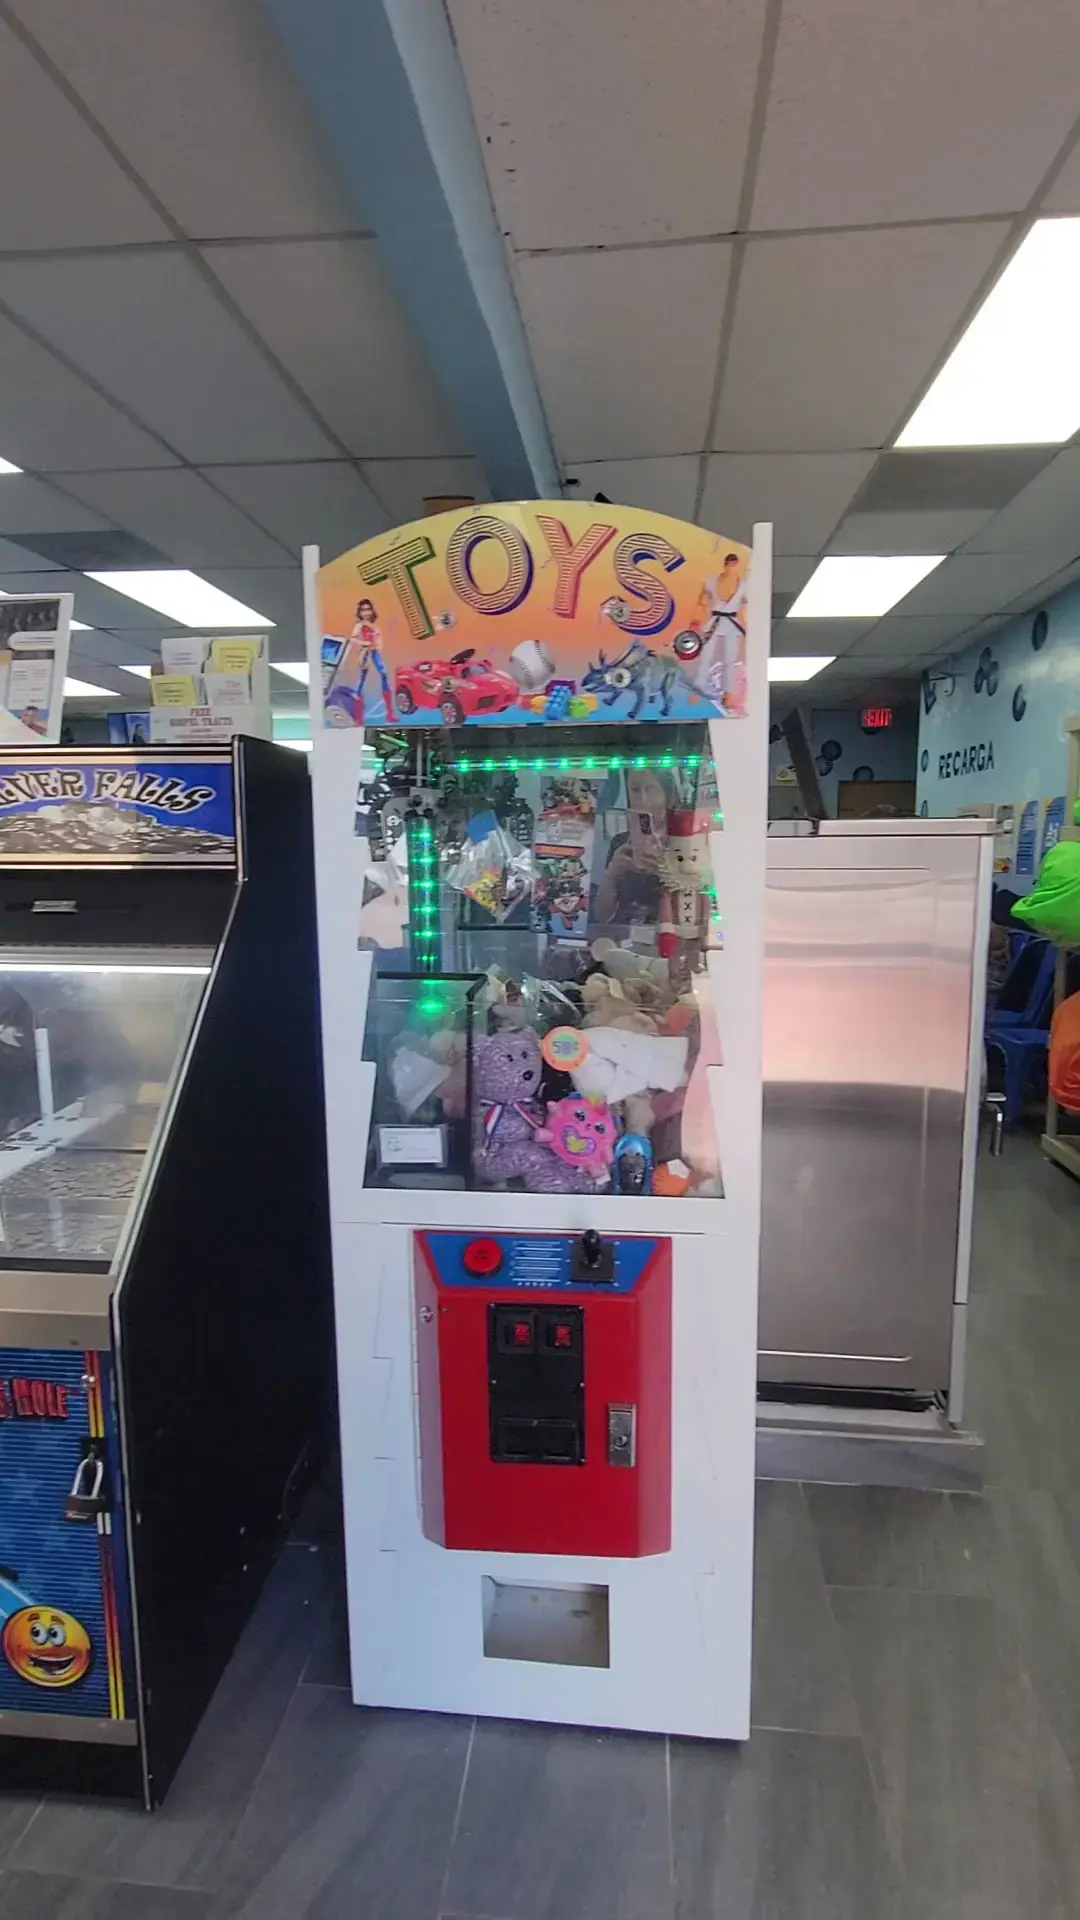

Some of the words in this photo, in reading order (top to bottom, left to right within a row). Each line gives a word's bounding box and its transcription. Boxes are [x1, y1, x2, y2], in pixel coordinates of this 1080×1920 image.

[357, 515, 685, 640] TOYS
[867, 706, 889, 727] EXIT
[938, 740, 995, 780] RECARGA
[94, 770, 215, 813] FALLS
